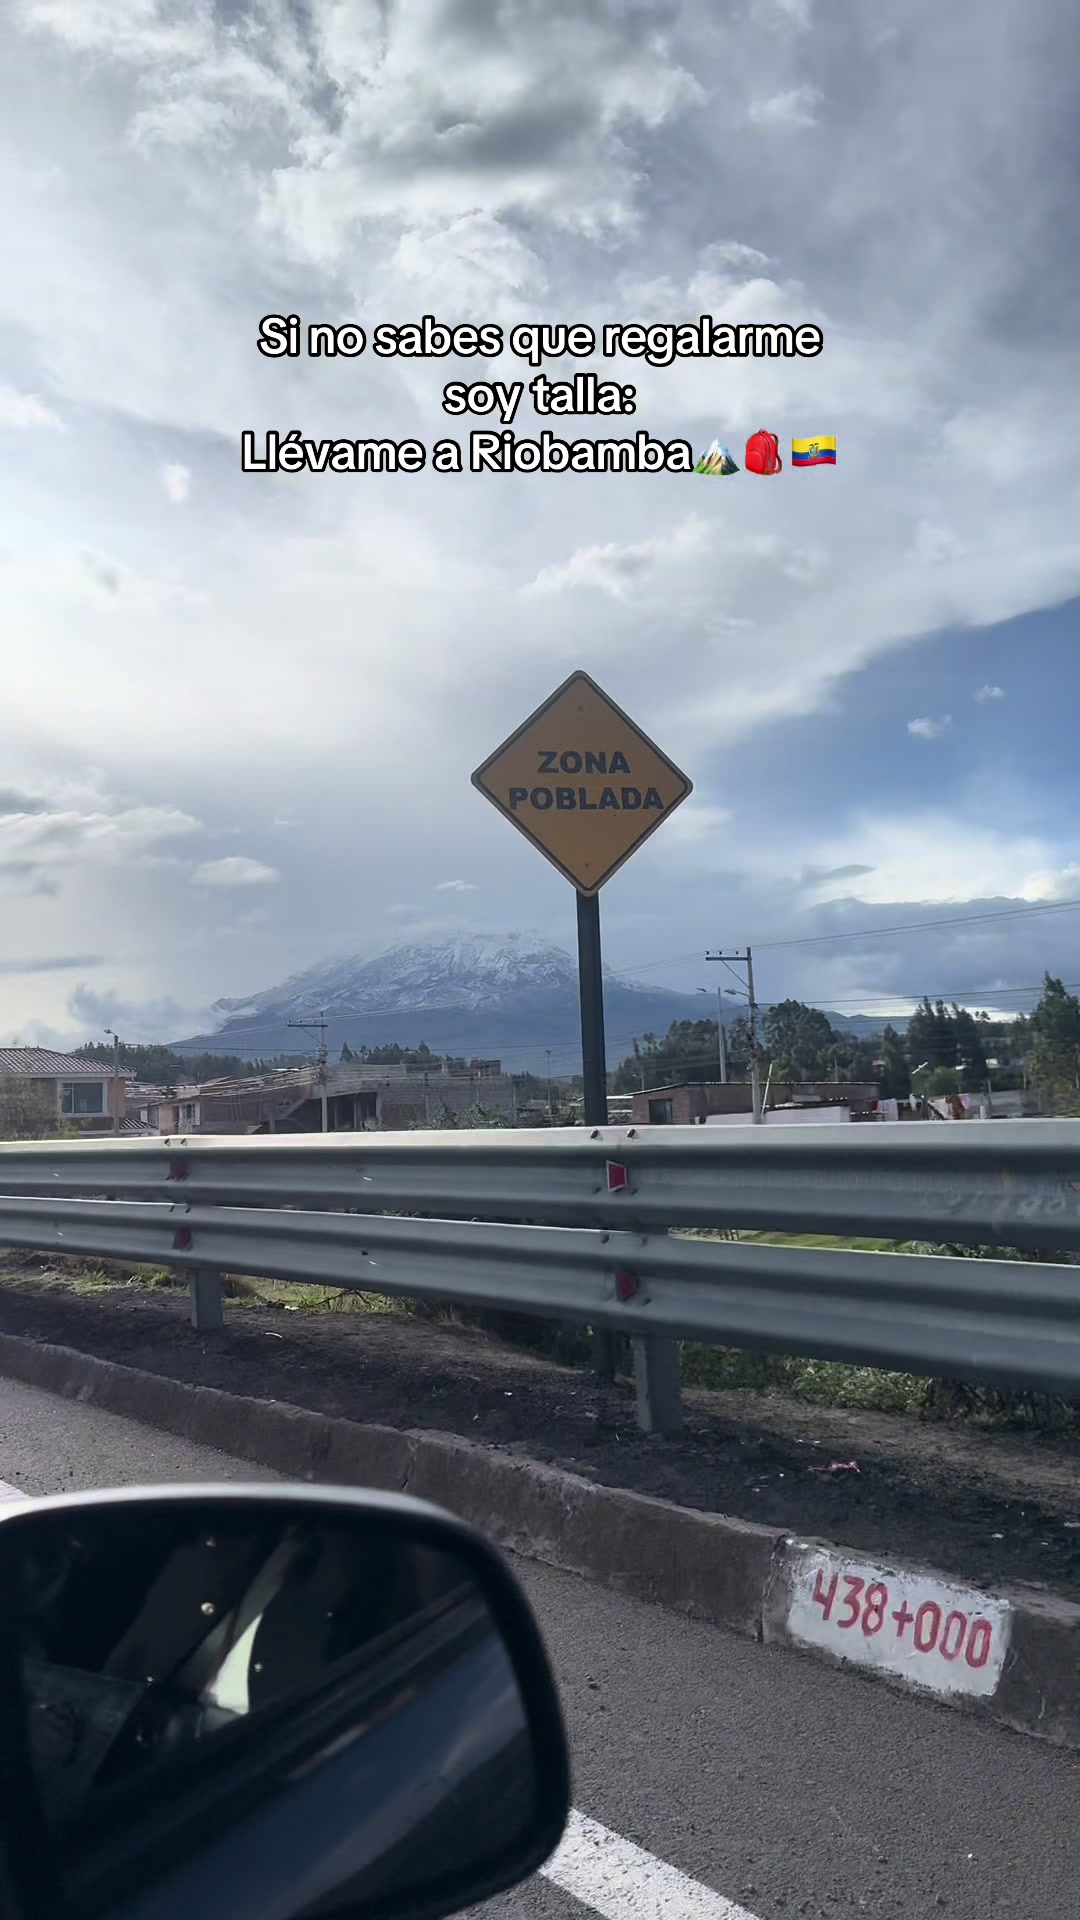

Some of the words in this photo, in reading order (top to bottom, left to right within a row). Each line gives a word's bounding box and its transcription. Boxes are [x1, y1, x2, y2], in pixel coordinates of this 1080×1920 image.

[537, 750, 631, 774] ZONA
[508, 786, 665, 810] POBLADA
[811, 1568, 993, 1669] 438+000
